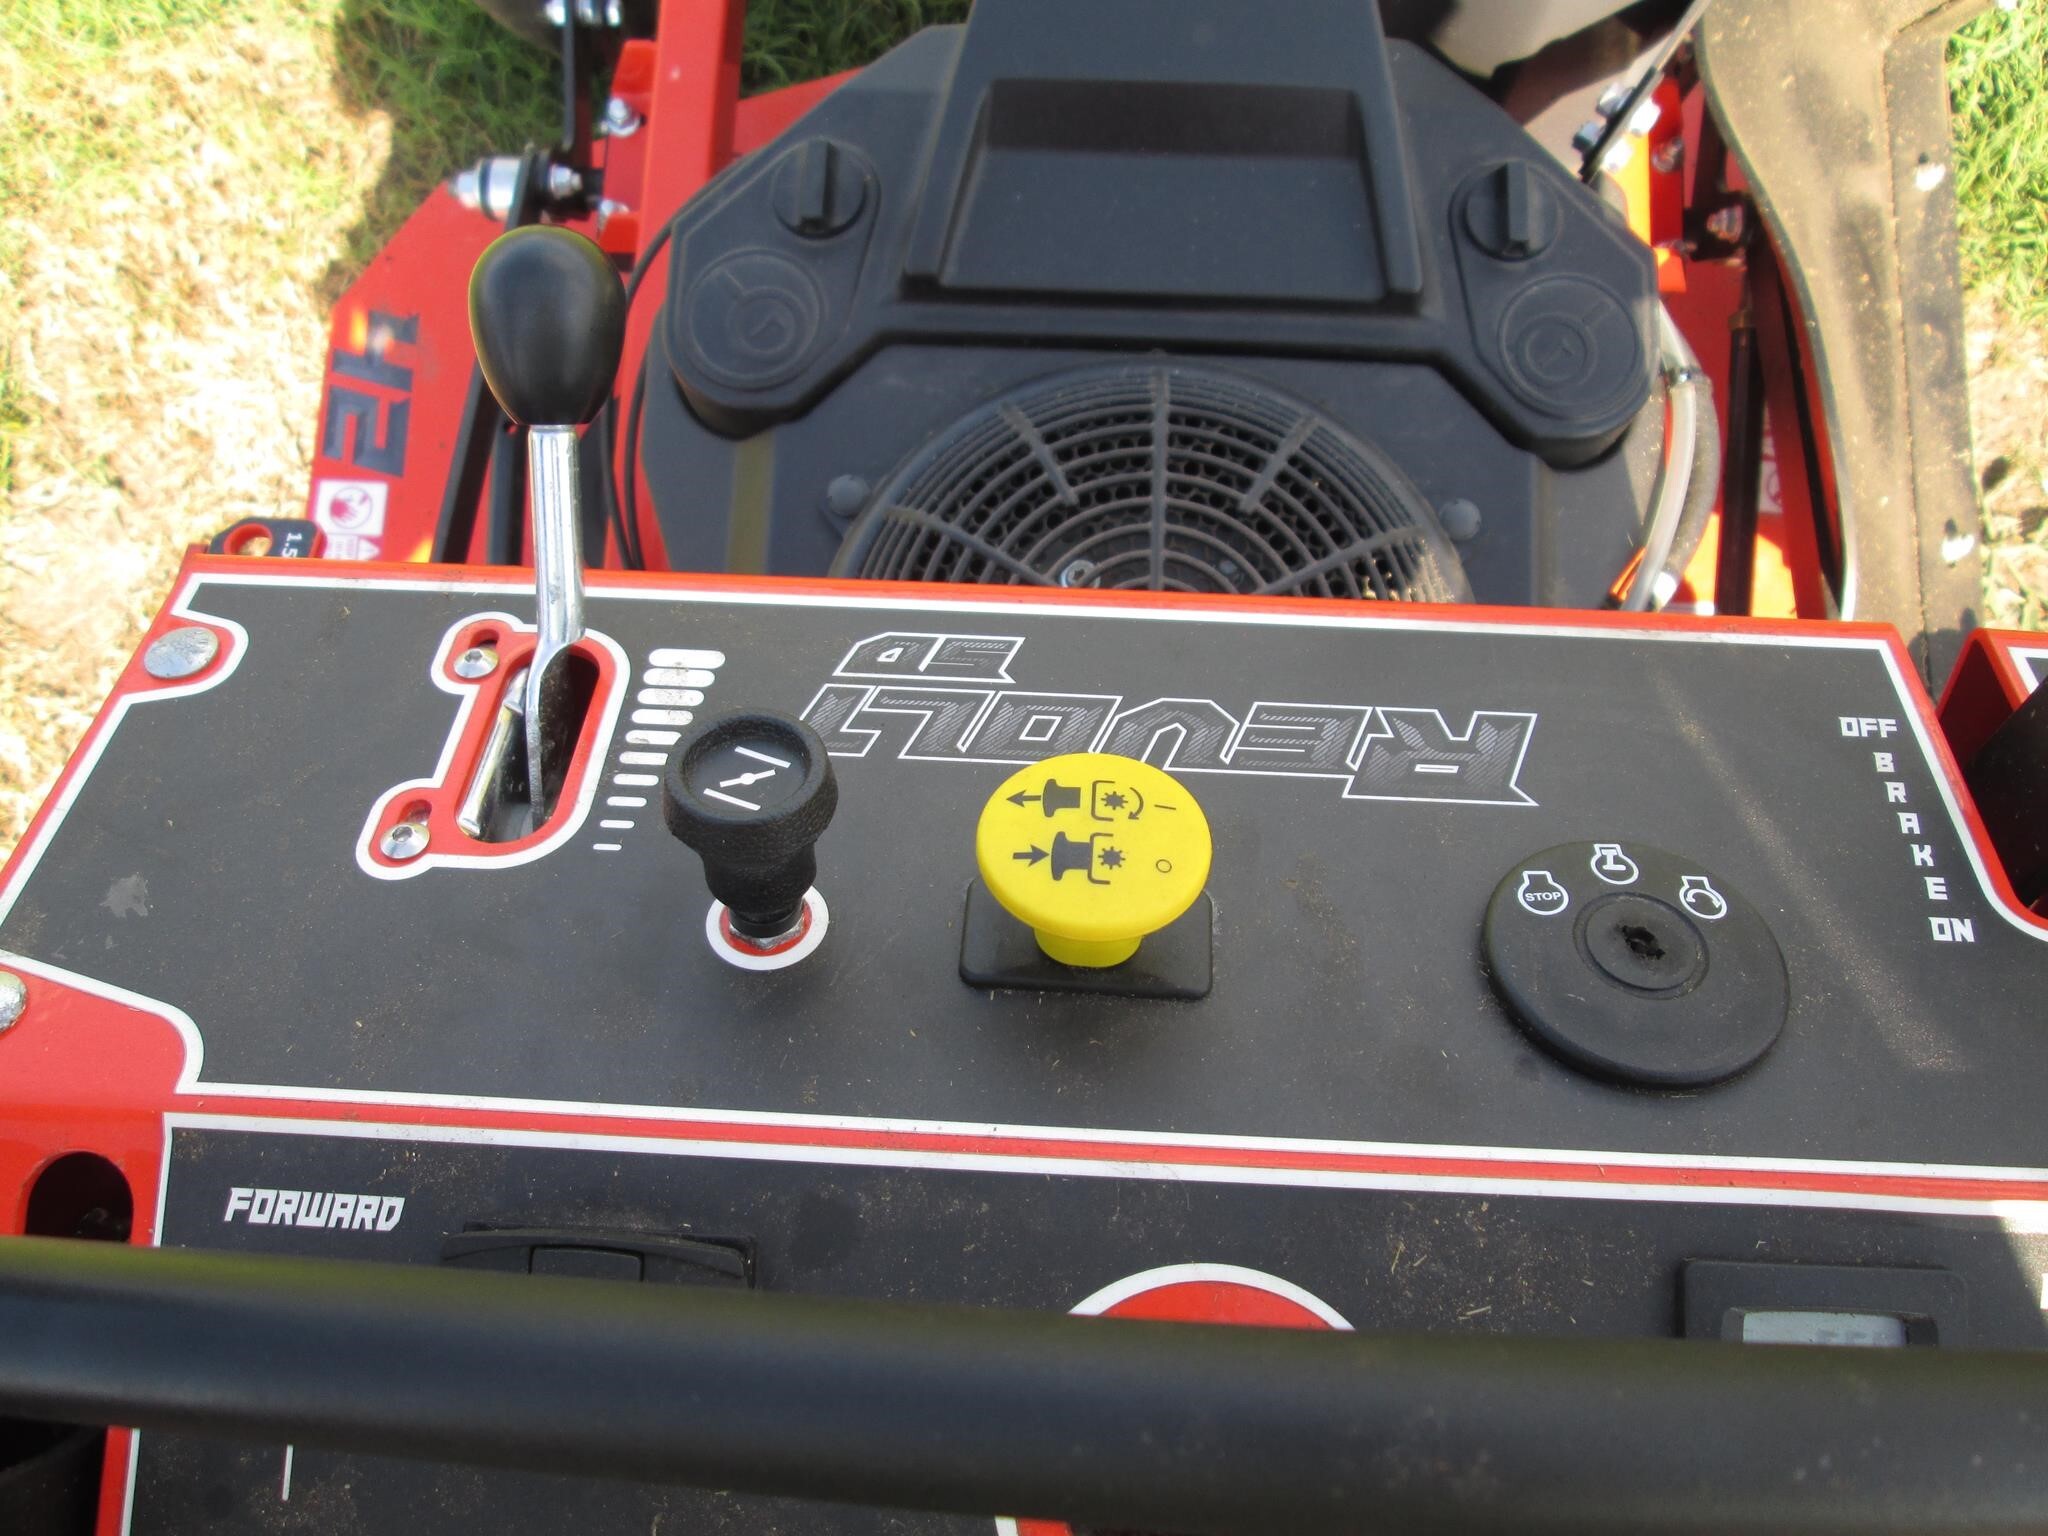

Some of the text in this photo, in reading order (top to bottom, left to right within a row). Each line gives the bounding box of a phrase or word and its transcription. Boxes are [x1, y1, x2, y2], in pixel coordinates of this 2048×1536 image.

[322, 310, 420, 478] 42
[799, 683, 1540, 806] REVOLT
[1838, 716, 1898, 738] OFF
[1525, 891, 1562, 902] STOP
[1927, 916, 1976, 943] ON
[223, 1186, 406, 1233] FORWARD
